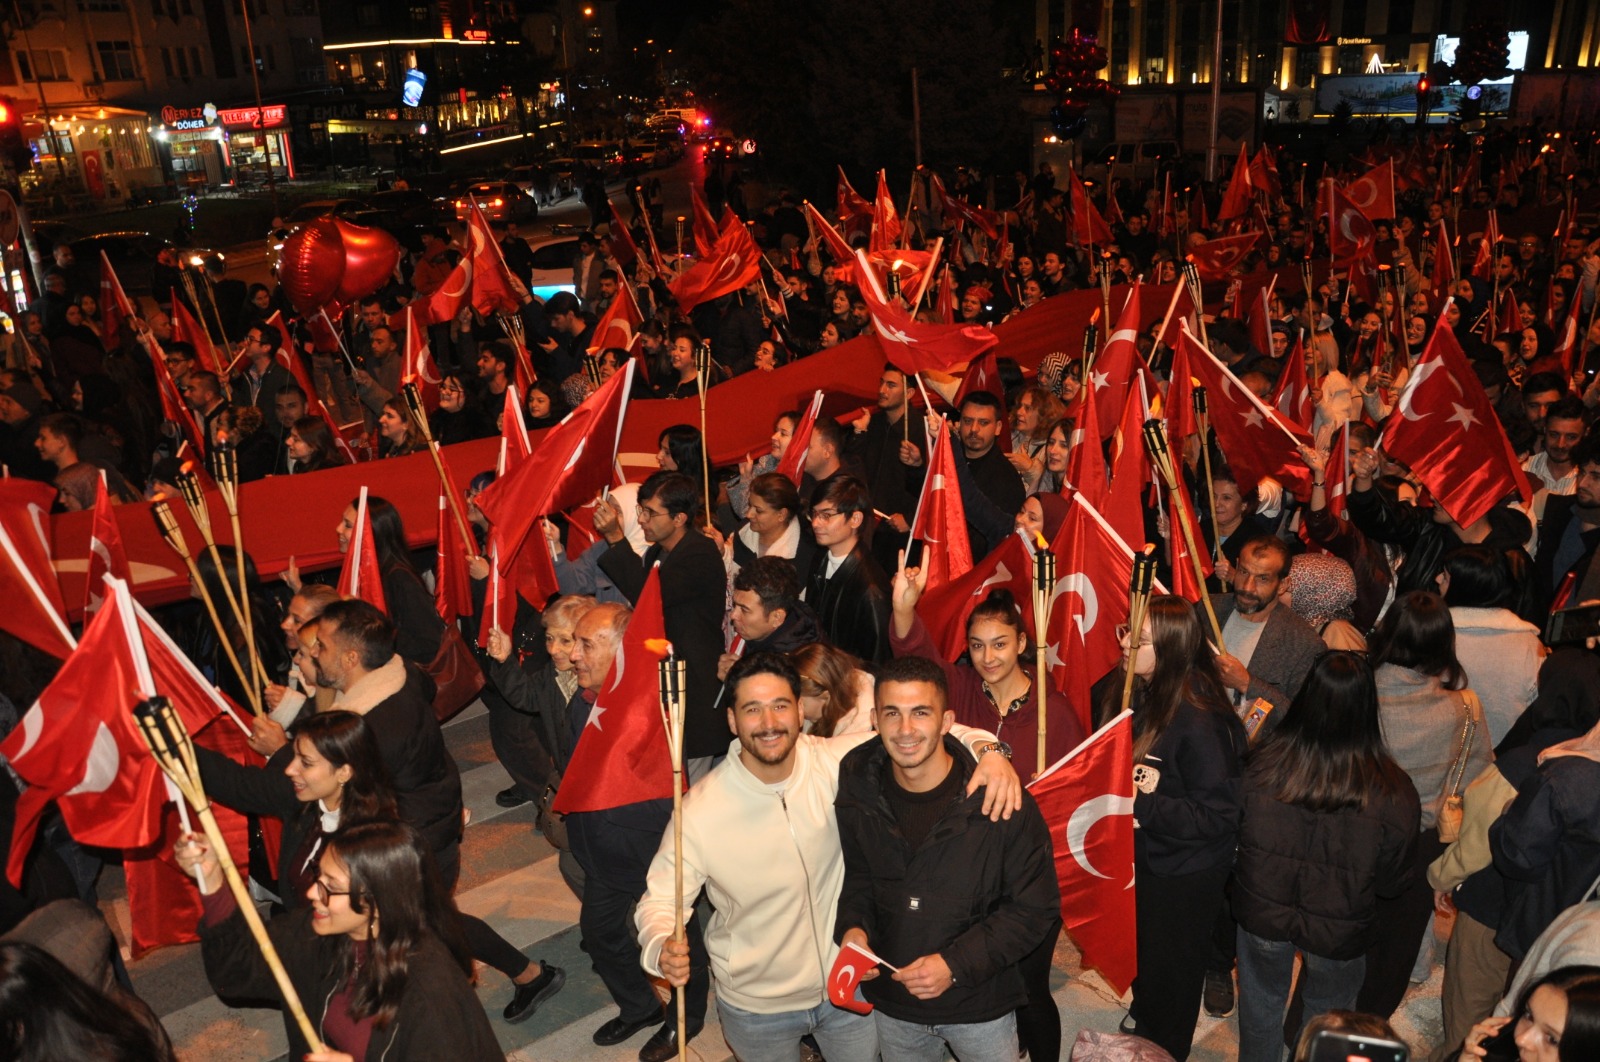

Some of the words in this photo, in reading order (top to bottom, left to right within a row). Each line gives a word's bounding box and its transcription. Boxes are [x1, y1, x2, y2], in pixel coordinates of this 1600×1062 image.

[163, 106, 203, 123] MERKEZ
[313, 103, 359, 121] EMLAK
[177, 119, 205, 130] DÖNER
